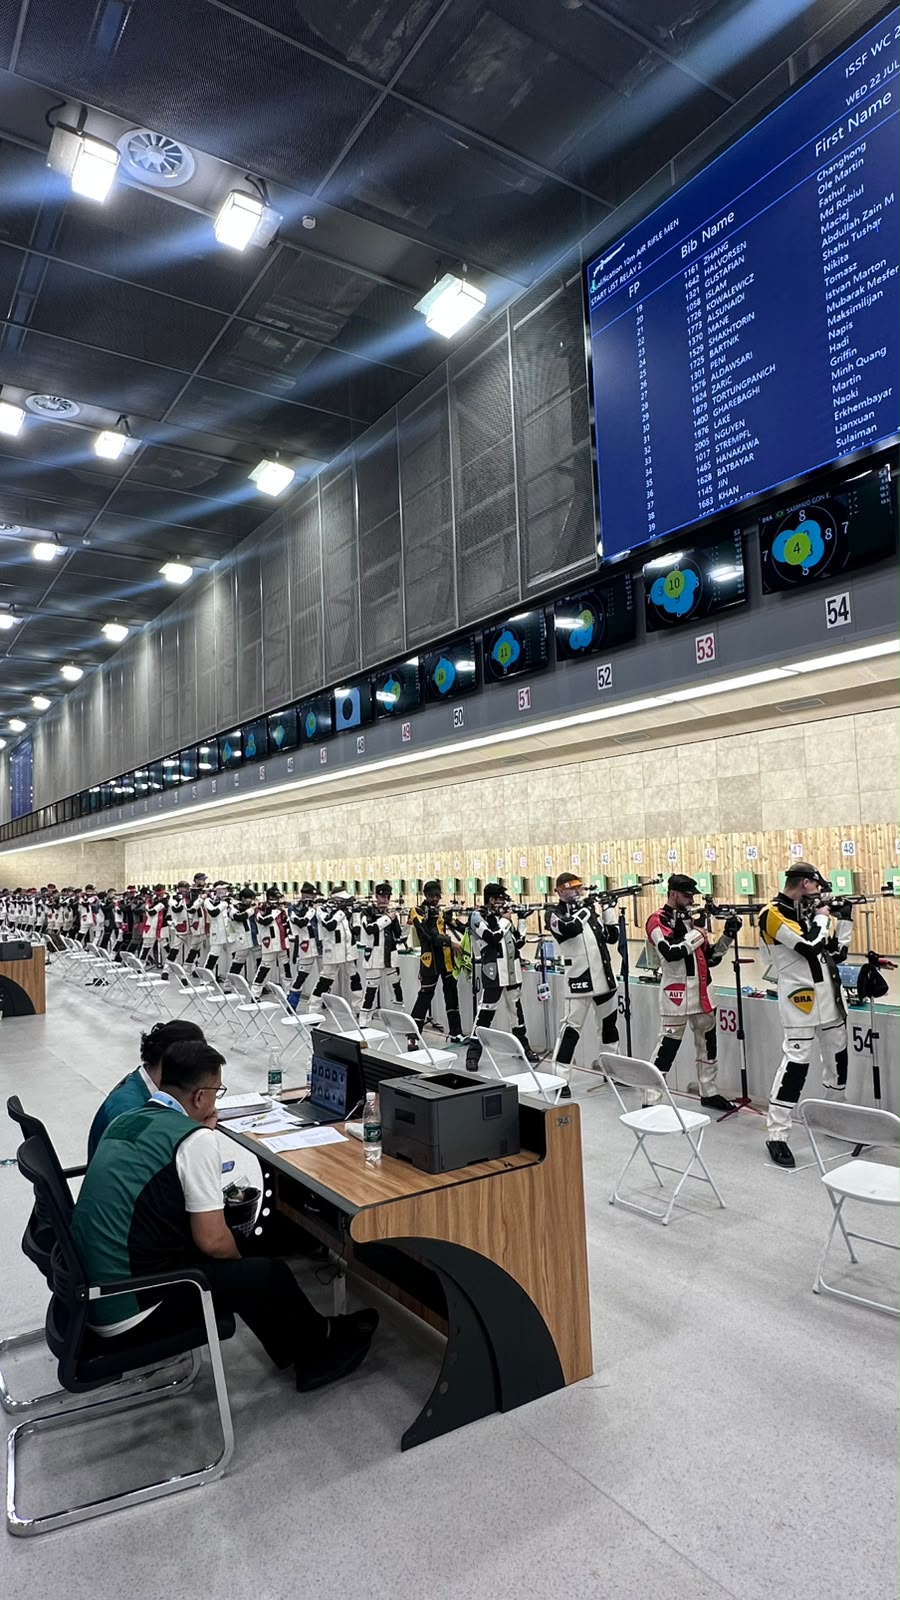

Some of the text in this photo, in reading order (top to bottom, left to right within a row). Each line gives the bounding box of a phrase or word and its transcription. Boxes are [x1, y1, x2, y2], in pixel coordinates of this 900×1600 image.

[845, 52, 868, 78] ISSF
[870, 33, 891, 56] WC
[846, 60, 900, 106] WED 22 JUL
[629, 92, 892, 298] FP Bib Name First Name
[636, 142, 866, 313] 19 1161 ZHANG Changhong
[636, 158, 864, 325] 20 1642 HALVORSEN Ole Martin
[647, 230, 663, 248] RIFLE
[664, 218, 679, 235] MEN
[591, 262, 642, 306] START LIST RELAY 2
[637, 184, 846, 336] 21 1321 GUSTAFIAN Fathur
[638, 184, 864, 347] 22 1058 ISLAM Md Robiul
[638, 208, 850, 357] 23 1726 KOWALEWICZ Maciej
[639, 193, 894, 368] 24 1773 ALSUNAIDI Abdullah Zain M
[640, 217, 882, 379] 25 1370 MANE Shahu Tushar
[640, 254, 849, 390] 26 1529 SHAKHTORIN Nikita
[641, 262, 858, 401] 27 1725 BARTNIK Tomasz
[641, 259, 887, 412] 28 1301 PENI Istvan Marton
[642, 265, 900, 422] 29 1576 ALDAWSARI Mubarak Mesfer
[643, 290, 884, 433] 30 1824 ZARIC Maksimilijan
[643, 321, 853, 444] 31 1879 TORTUNGPANICH Napis
[644, 335, 849, 455] 32 1400 GHAREBAGHI Hadi
[644, 348, 857, 466] 33 1976 LAKE Griffin
[645, 346, 887, 477] 34 2005 NGUYEN Minh Quang
[646, 374, 862, 488] 35 1017 STREMPFL Martin
[646, 388, 859, 499] 36 1465 HANAKAWA Naoki
[647, 387, 892, 510] 37 1628 BATBAYAR Erkhembayar
[648, 411, 875, 521] 38 1145 JIN Lianxuan
[648, 523, 656, 532] 39
[698, 497, 714, 509] 1683
[718, 485, 740, 501] KHAN
[836, 424, 878, 448] Sulaiman
[762, 550, 768, 562] 7
[793, 542, 800, 554] 4
[799, 510, 806, 521] 8
[825, 528, 832, 540] 8
[842, 521, 849, 534] 7
[669, 578, 680, 591] 10
[827, 596, 849, 624] 54
[519, 689, 530, 708] 51
[598, 666, 611, 688] 52
[697, 637, 714, 660] 53
[454, 709, 463, 726] 50
[706, 850, 715, 860] 45
[748, 848, 756, 858] 46
[792, 845, 802, 856] 47
[843, 843, 854, 854] 48
[719, 1010, 736, 1032] 53
[853, 1026, 873, 1053] 54
